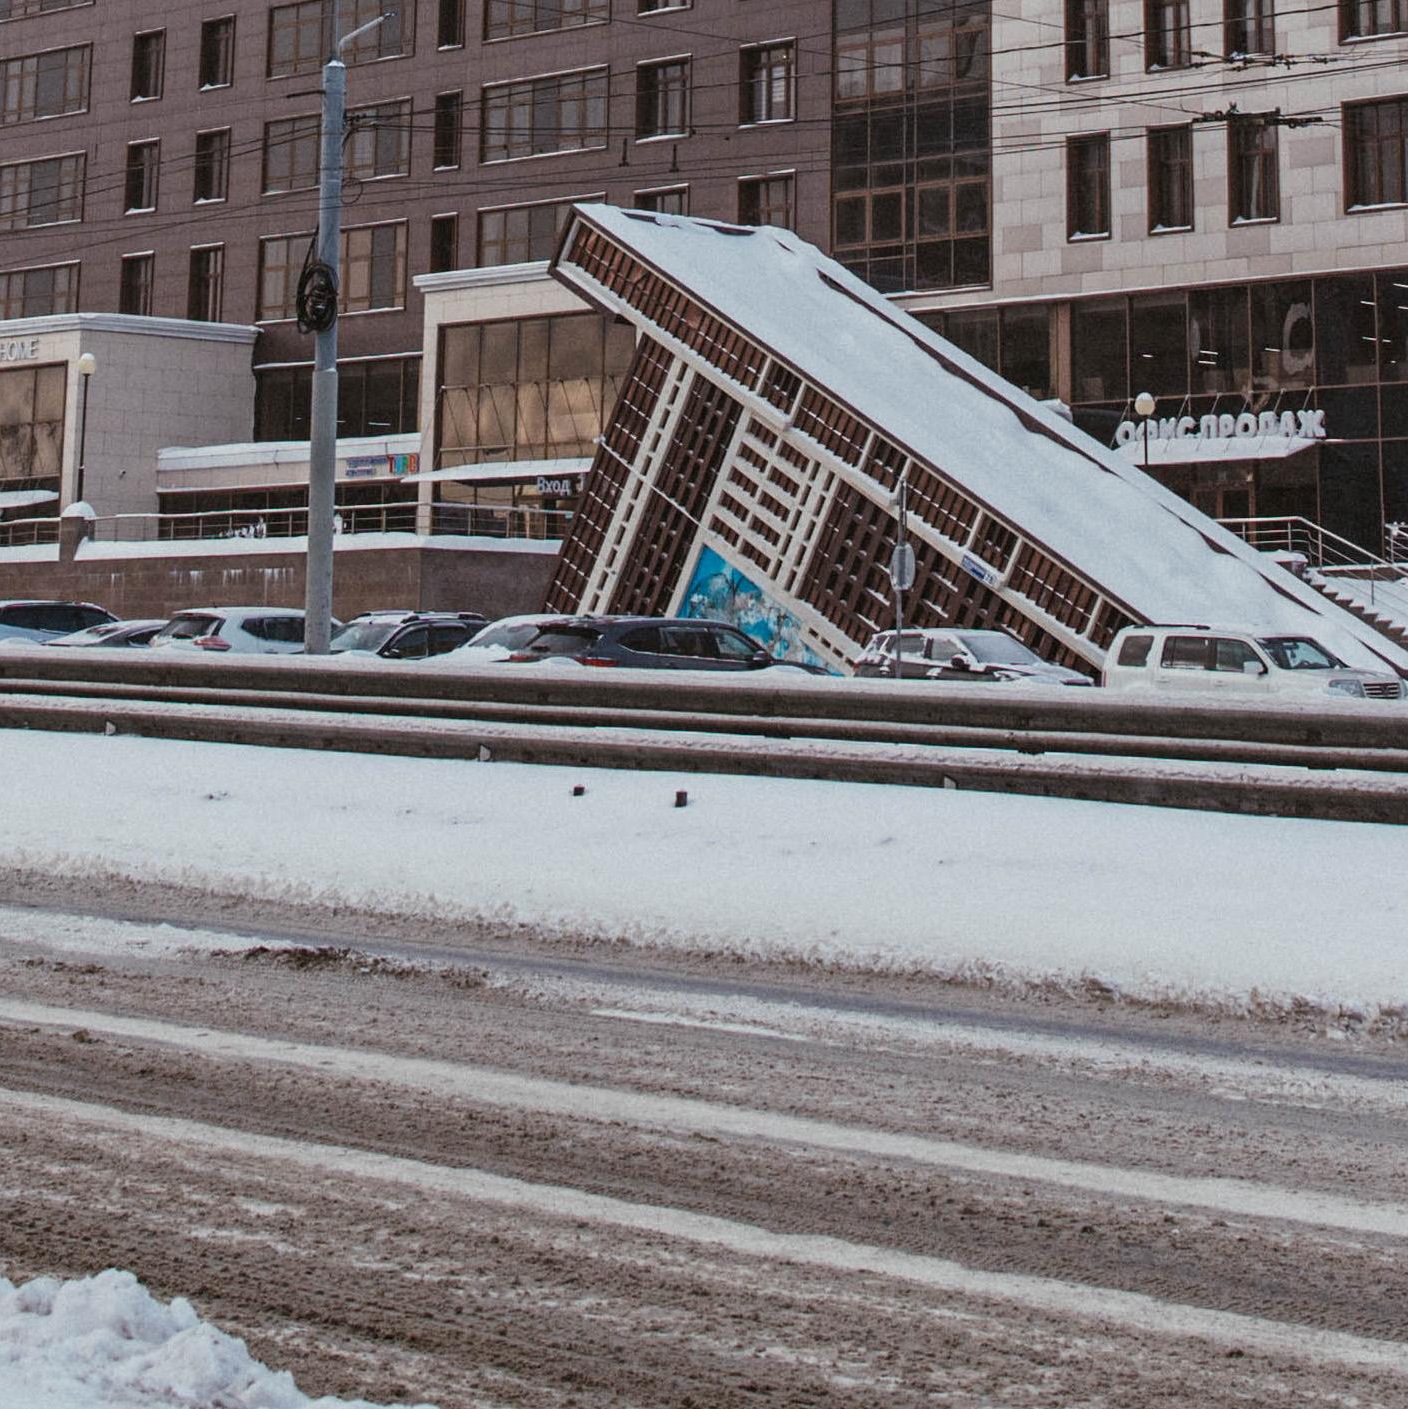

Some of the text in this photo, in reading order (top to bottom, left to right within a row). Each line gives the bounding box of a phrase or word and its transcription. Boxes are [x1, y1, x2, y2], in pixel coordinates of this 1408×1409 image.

[1115, 409, 1327, 446] ОФИС ПРОДАЖ
[536, 476, 571, 496] Вход
